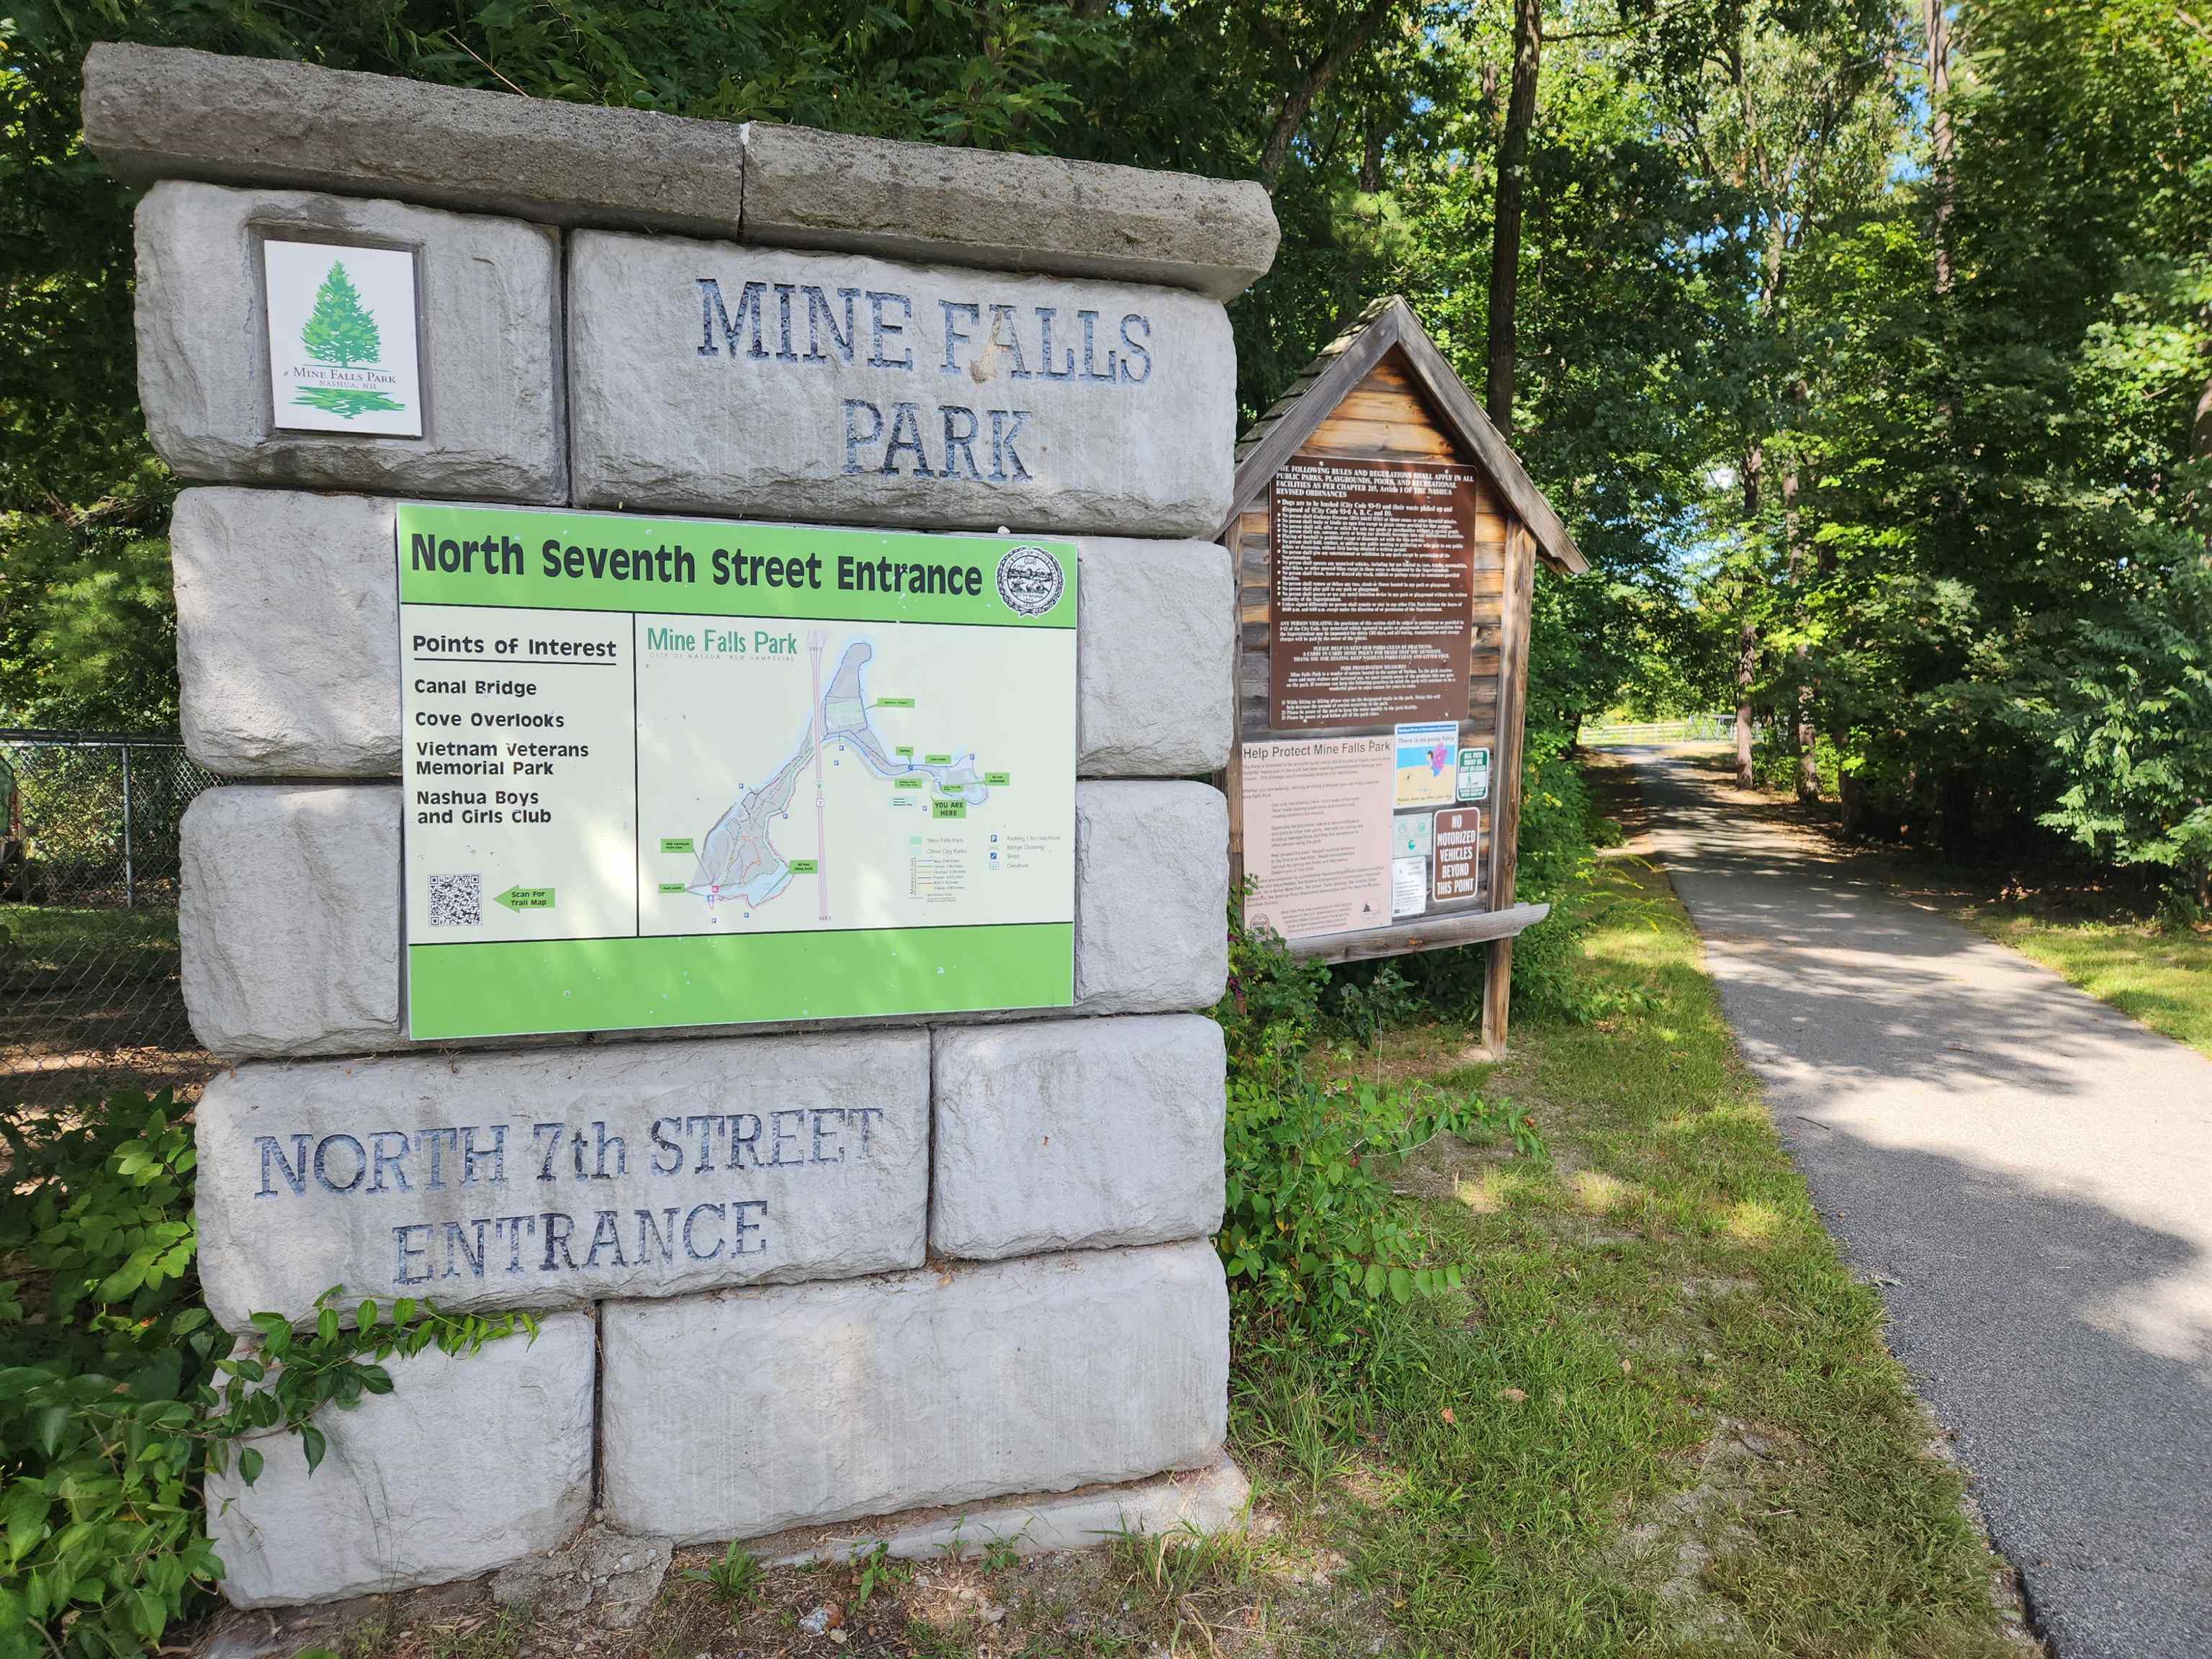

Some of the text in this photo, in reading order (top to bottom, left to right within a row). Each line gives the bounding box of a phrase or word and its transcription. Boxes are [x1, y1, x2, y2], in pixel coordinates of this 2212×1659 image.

[696, 278, 1151, 384] MINE FALLS
[841, 399, 1034, 482] PARK
[1292, 466, 1330, 475] FOLLOWING
[1370, 470, 1413, 479] REGULATIONS
[1305, 489, 1348, 498] ORDINANCES
[411, 534, 525, 575] North
[542, 539, 696, 583] Seventh
[711, 548, 822, 589] Street
[837, 555, 983, 596] Entrance
[413, 635, 616, 657] Points of Interest
[647, 627, 797, 655] Mine Falls Park
[414, 679, 537, 697] Canal Bridge
[415, 712, 565, 727] Cove Overlooks
[416, 742, 589, 757] Vietnam Veterans
[1244, 740, 1390, 760] Help Protect Mine Falls Park
[416, 760, 554, 775] Memorial Park
[416, 790, 539, 806] Nashua Boys
[418, 809, 552, 824] and Girls Club
[1452, 815, 1462, 829] NO
[1437, 830, 1476, 847] MOTORIZED
[1440, 846, 1473, 862] VEHICLES
[1442, 863, 1470, 878] BEYOND
[1437, 881, 1452, 895] THIS
[1455, 878, 1475, 893] POINT
[254, 1107, 883, 1199] NORTH 7th STREET
[392, 1200, 768, 1285] ENTRANCE
